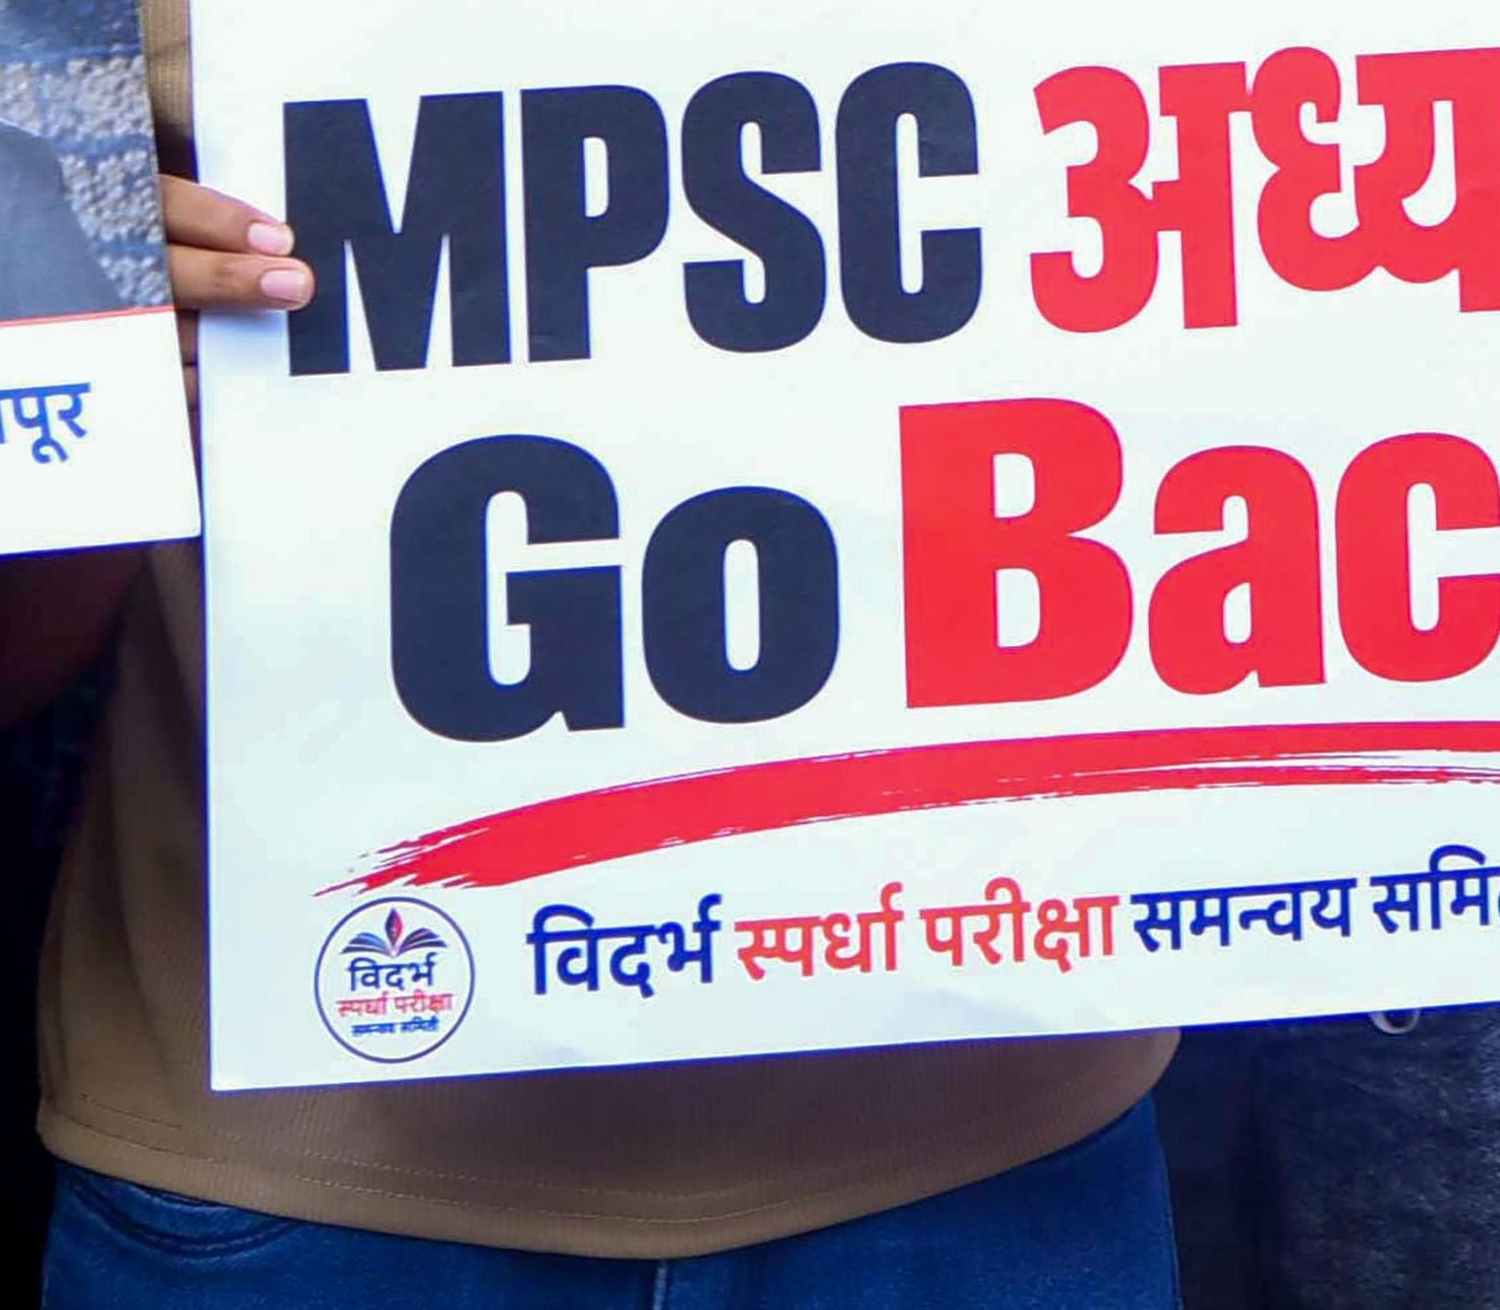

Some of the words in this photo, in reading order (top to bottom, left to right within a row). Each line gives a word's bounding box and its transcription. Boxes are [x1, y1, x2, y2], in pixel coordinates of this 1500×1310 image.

[282, 60, 985, 378] MPSC
[388, 432, 842, 742] Go
[347, 952, 437, 991] विदर्भ
[526, 894, 722, 998] विदर्भ
[734, 882, 904, 982] स्पर्धा
[920, 876, 1120, 974] परीक्षा
[1130, 877, 1358, 953] समन्वय
